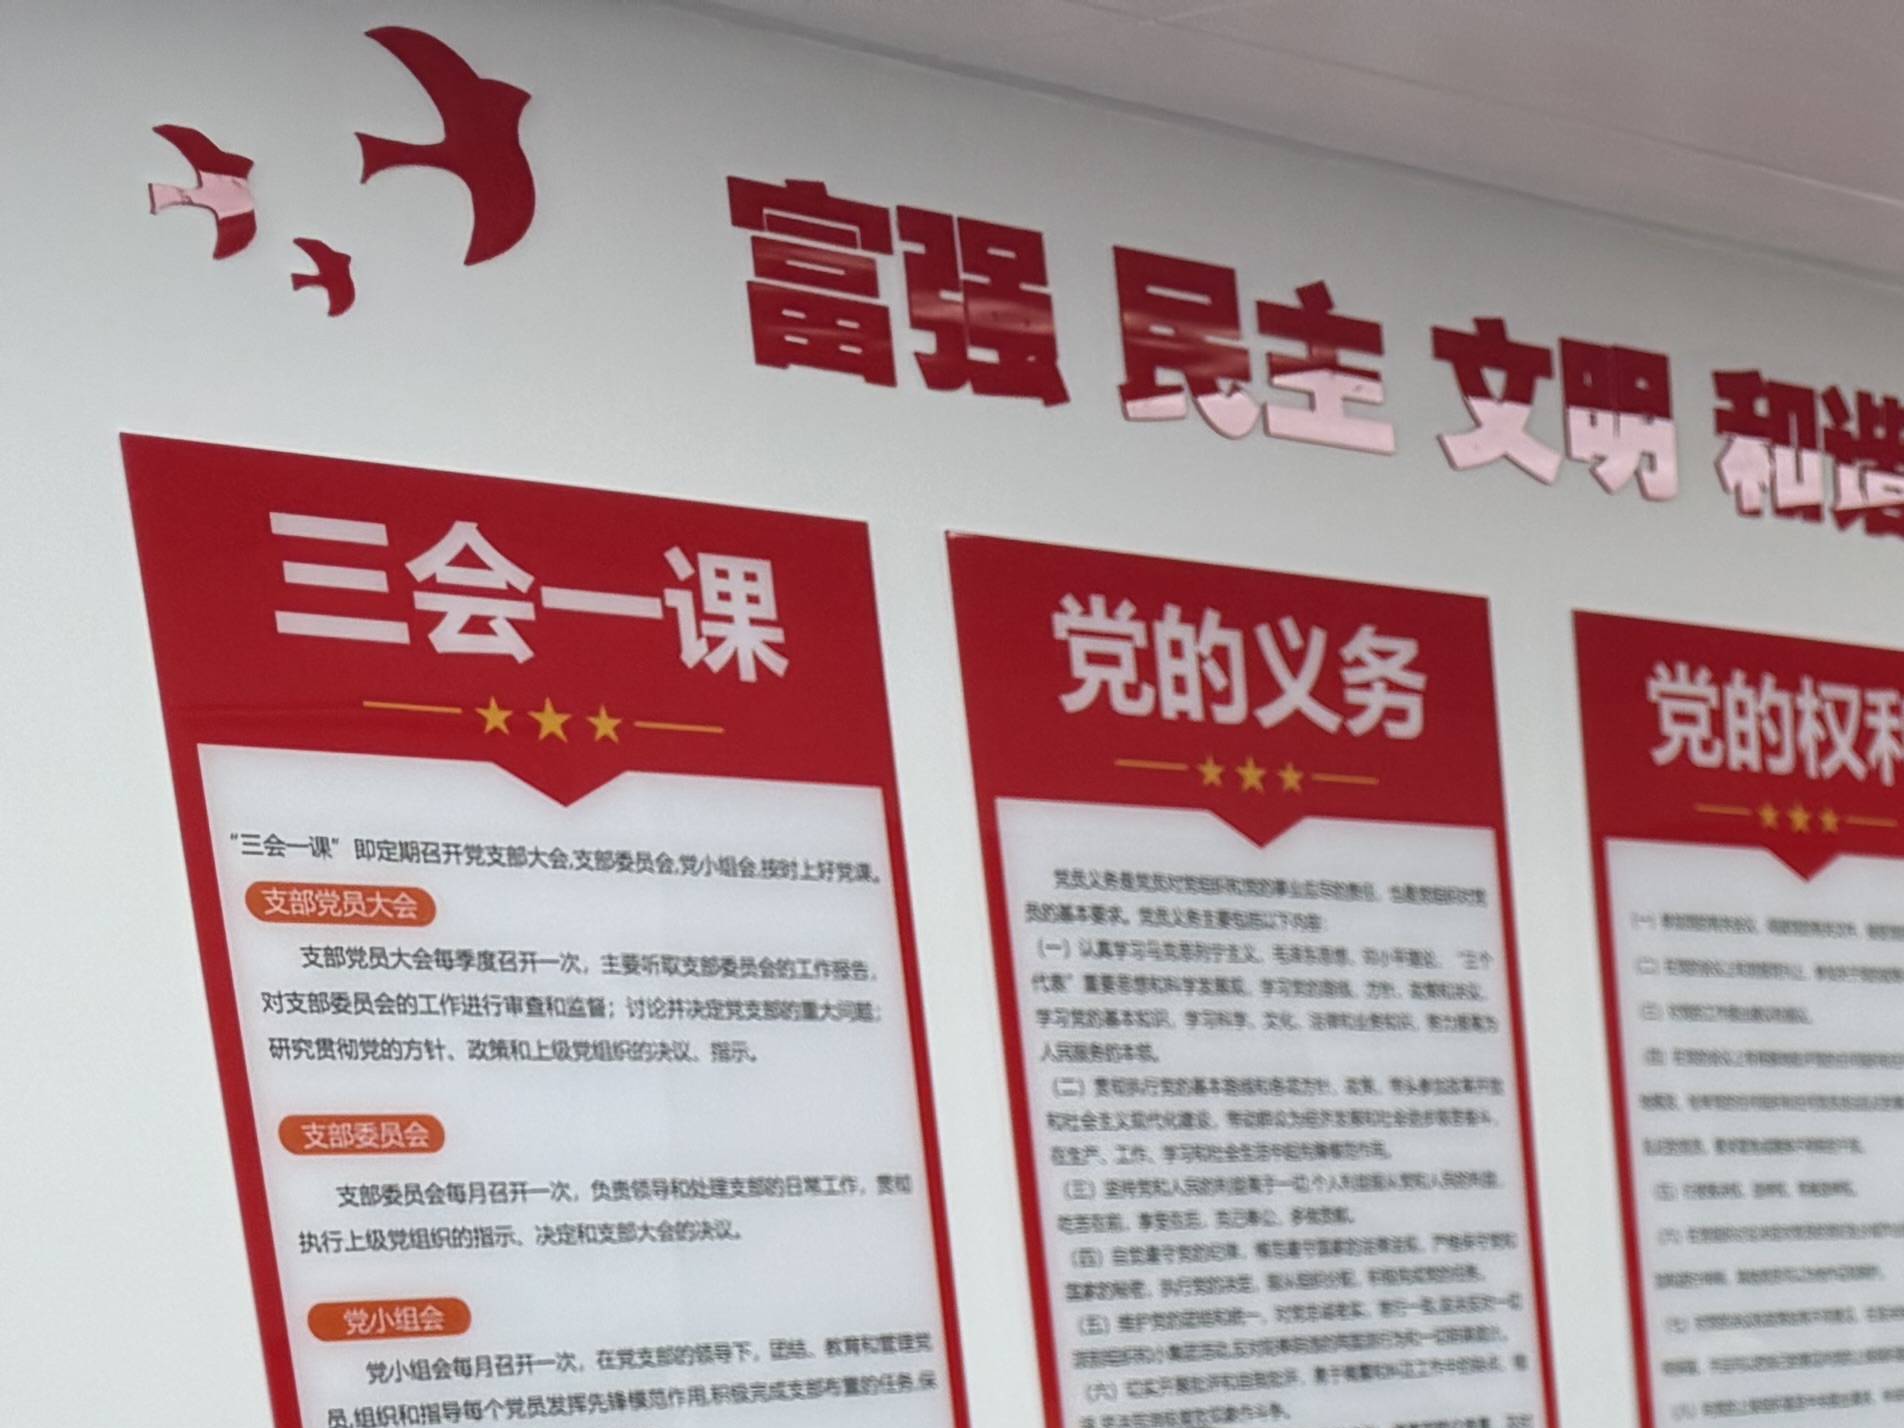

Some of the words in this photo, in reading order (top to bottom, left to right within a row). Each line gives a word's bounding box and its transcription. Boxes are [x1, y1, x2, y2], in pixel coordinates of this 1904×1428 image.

[727, 176, 1069, 406] 富强
[1113, 245, 1395, 454] 民主
[1431, 317, 1678, 500] 文明
[269, 512, 789, 683] 三会一课
[1051, 594, 1429, 739] 党的义务
[261, 888, 418, 920] 支部党员大会
[301, 1121, 430, 1149] 支部委员会
[343, 1305, 445, 1335] 党小组会
